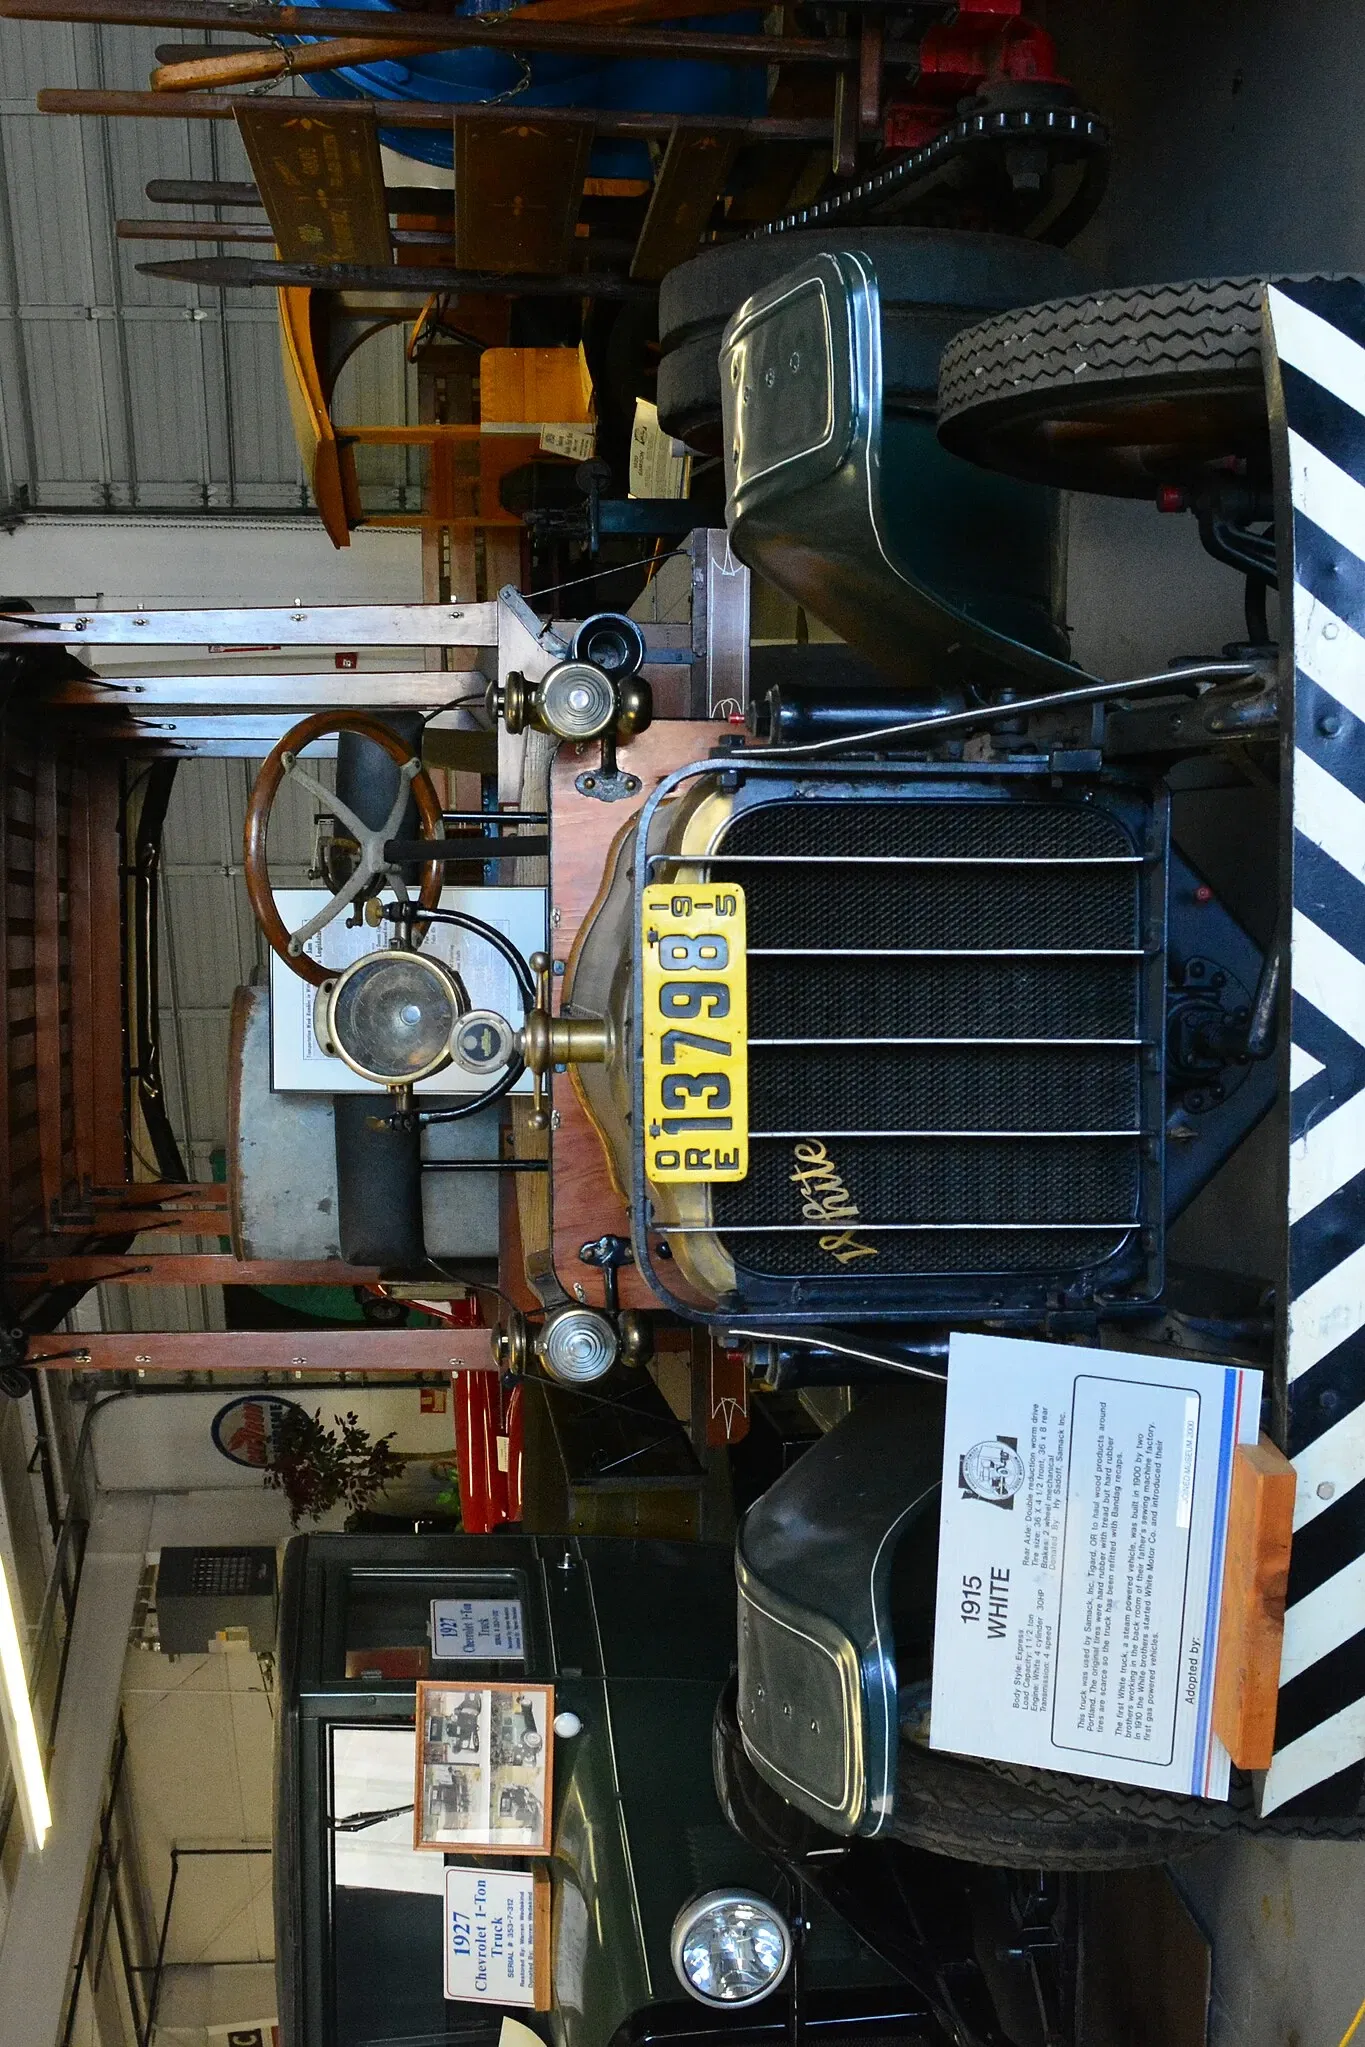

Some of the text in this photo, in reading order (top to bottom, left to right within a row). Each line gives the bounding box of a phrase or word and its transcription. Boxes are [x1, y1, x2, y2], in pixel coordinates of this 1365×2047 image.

[657, 933, 733, 1136] 13798
[654, 1148, 739, 1170] ORE
[788, 1137, 878, 1265] White
[1030, 1403, 1039, 1424] drive
[1098, 1401, 1107, 1432] around
[1037, 1444, 1046, 1456] 36
[1106, 1436, 1114, 1465] rubber
[1135, 1433, 1144, 1449] two
[1095, 1435, 1104, 1473] products
[1134, 1452, 1143, 1464] by
[1184, 1439, 1193, 1474] MUSEUM
[1027, 1452, 1036, 1491] reduction
[1036, 1459, 1045, 1480] front,
[1046, 1455, 1054, 1502] mechanical
[1103, 1467, 1112, 1487] hard
[1114, 1452, 1123, 1483] recaps.
[1132, 1466, 1141, 1487] 1900
[1048, 1412, 1066, 1571] Donated Hy Sadoff, Samack Inc.
[1094, 1475, 1102, 1499] wood
[1102, 1489, 1110, 1504] but
[1131, 1490, 1139, 1498] in
[1024, 1494, 1033, 1522] Double
[1091, 1501, 1100, 1519] haul
[1110, 1486, 1122, 1518] Bandag
[1130, 1501, 1139, 1520] built
[1033, 1517, 1041, 1528] 36
[1043, 1504, 1051, 1528] wheel
[1090, 1522, 1098, 1531] to
[1100, 1506, 1109, 1529] tread
[1023, 1525, 1031, 1545] Axle:
[1032, 1532, 1040, 1549] size:
[1089, 1534, 1097, 1547] OR
[1110, 1520, 1118, 1538] with
[1130, 1522, 1138, 1539] was
[1021, 1547, 1030, 1567] Rear
[1030, 1552, 1039, 1567] Tire
[1040, 1541, 1048, 1570] Brakes:
[1087, 1550, 1097, 1578] Tigard,
[1098, 1552, 1106, 1580] rubber
[1107, 1541, 1116, 1572] refitted
[1127, 1542, 1136, 1573] vehicle,
[1086, 1581, 1094, 1595] Inc.
[1096, 1582, 1104, 1601] hard
[1106, 1574, 1114, 1596] been
[1124, 1422, 1154, 1739] brothers working in the back room of their father's sewing machine factory.
[1133, 1440, 1163, 1740] In 1910 the White brothers started White Motor Co. and introduced their
[960, 1575, 982, 1624] 1915
[987, 1566, 1010, 1639] WHITE
[1036, 1589, 1044, 1612] 30HP
[1125, 1575, 1134, 1612] powered
[1083, 1598, 1094, 1633] Samack,
[1095, 1603, 1103, 1623] were
[1104, 1599, 1113, 1614] has
[439, 1617, 458, 1638] 1927
[1026, 1614, 1034, 1627] ton
[1103, 1616, 1111, 1637] truck
[1122, 1614, 1130, 1640] steam
[1034, 1617, 1043, 1648] cylinder
[1082, 1636, 1092, 1646] by
[1093, 1626, 1101, 1644] tires
[1101, 1640, 1110, 1653] the
[1012, 1629, 1024, 1709] Body Style: Express
[1032, 1659, 1040, 1681] White
[1039, 1662, 1049, 1713] Transmission:
[1044, 1625, 1052, 1650] speed
[1082, 1648, 1090, 1669] used
[1091, 1647, 1100, 1677] original
[1102, 1656, 1108, 1667] so
[1119, 1651, 1129, 1674] truck,
[1022, 1652, 1032, 1689] Capacity:
[1184, 1636, 1201, 1705] Adopted by:
[1088, 1679, 1097, 1694] The
[1099, 1669, 1108, 1697] scarce
[1117, 1677, 1126, 1700] White
[1142, 1632, 1159, 1742] first gas powered vehicles.
[1021, 1690, 1030, 1711] Load
[1030, 1684, 1039, 1712] Engine:
[1078, 1690, 1087, 1711] truck
[1076, 1714, 1085, 1729] This
[1086, 1698, 1096, 1732] Portland.
[1115, 1702, 1124, 1719] first
[1096, 1716, 1104, 1733] tires
[1114, 1722, 1123, 1736] The
[452, 1911, 470, 1957] 1927
[474, 1879, 487, 1992] Chevrolet 1-Ton
[491, 1916, 503, 1958] Truck
